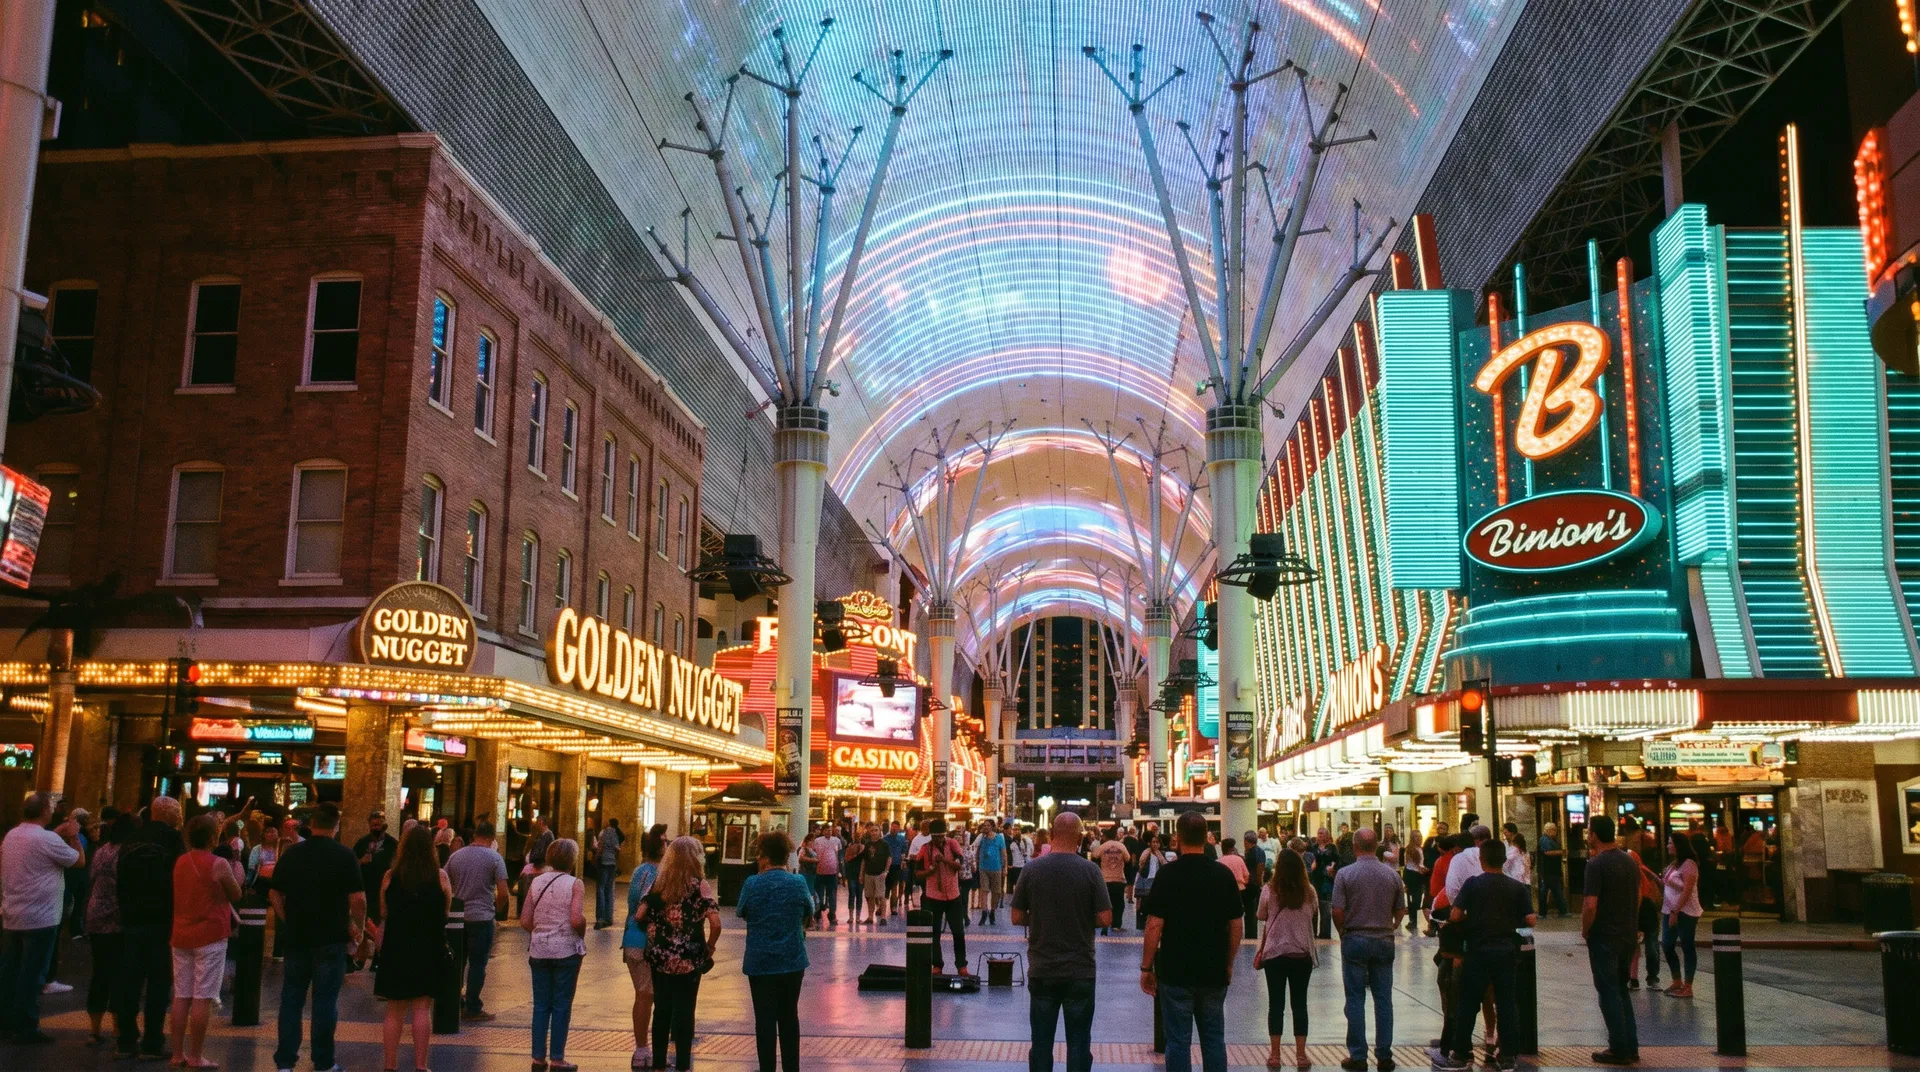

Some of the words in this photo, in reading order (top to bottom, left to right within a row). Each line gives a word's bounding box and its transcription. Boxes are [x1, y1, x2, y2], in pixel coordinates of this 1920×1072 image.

[1475, 321, 1611, 461] B
[1481, 508, 1633, 558] Binion's
[374, 608, 469, 640] GOLDEN
[371, 635, 468, 666] NUGGET
[554, 607, 665, 711] GOLDEN
[667, 654, 744, 735] NUGGET
[1330, 644, 1384, 729] BINION'S
[833, 746, 919, 771] CASINO
